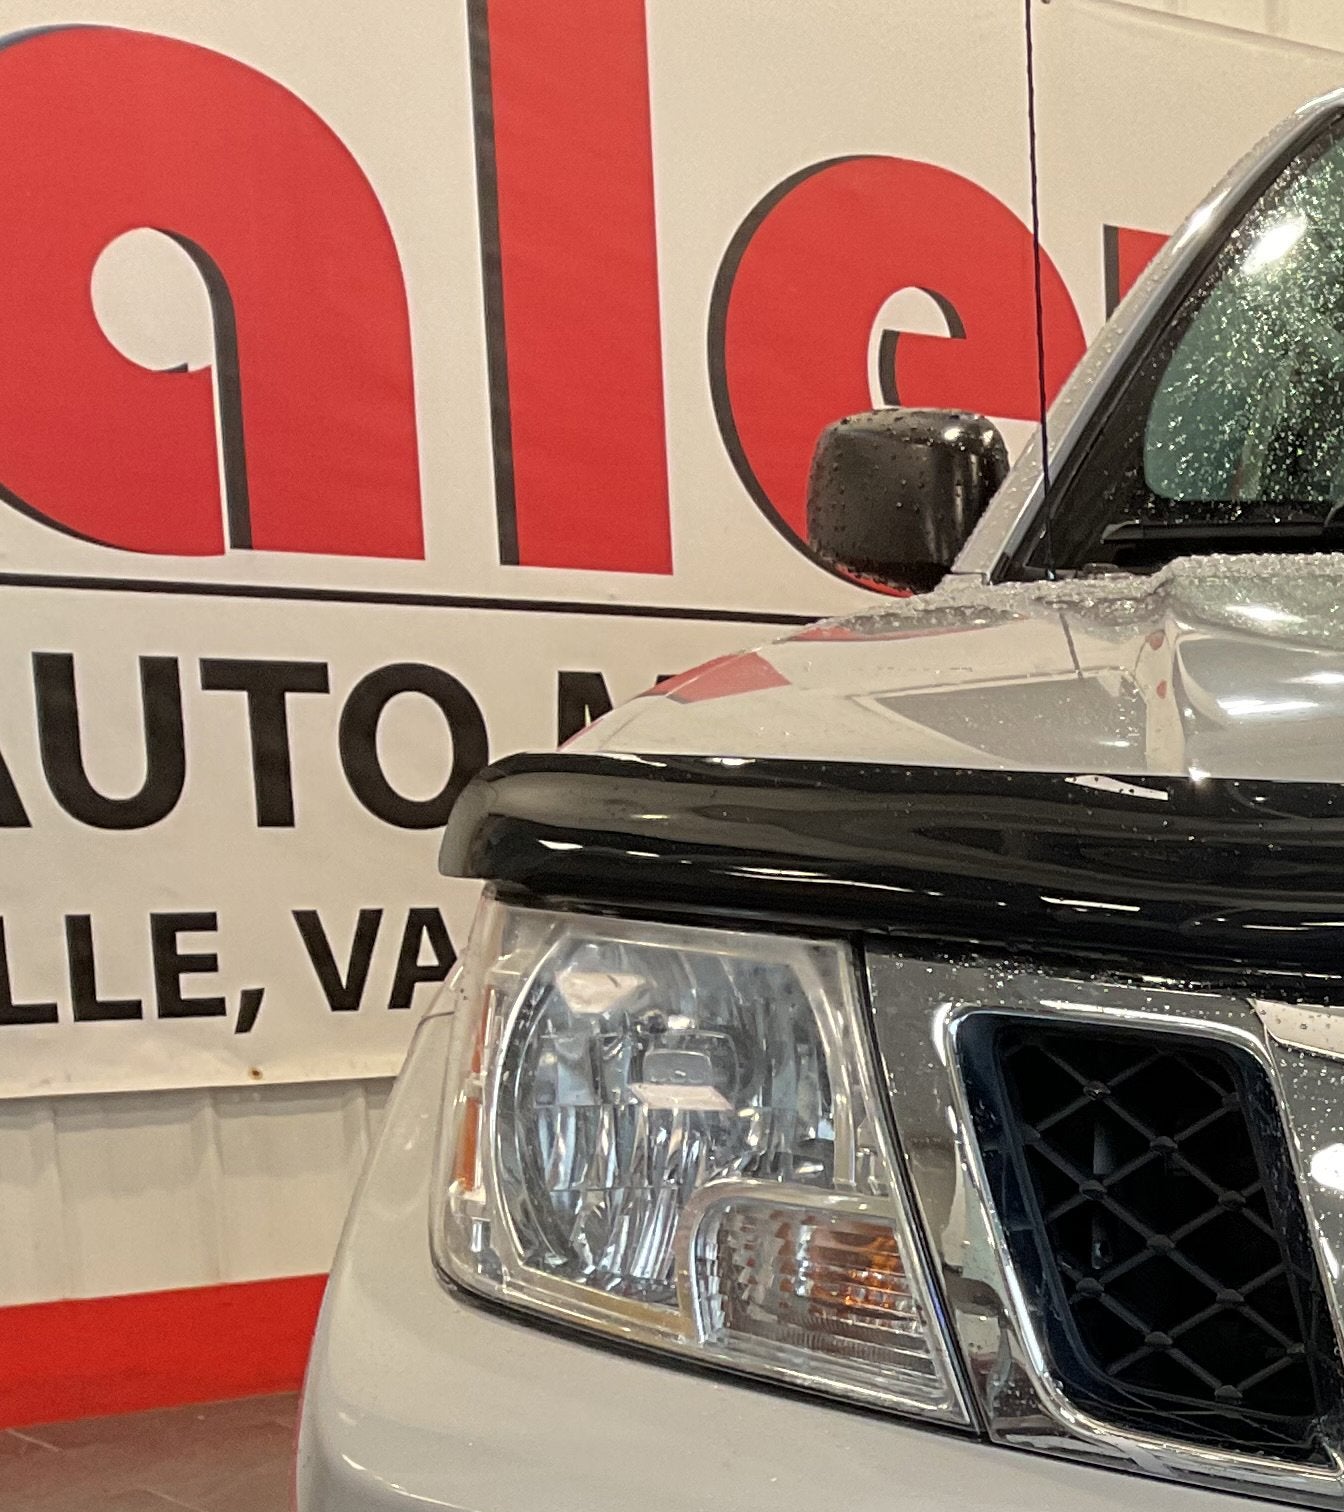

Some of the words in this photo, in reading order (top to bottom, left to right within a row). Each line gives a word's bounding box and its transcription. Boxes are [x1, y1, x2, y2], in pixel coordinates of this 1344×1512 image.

[0, 0, 1172, 597] ale
[0, 652, 489, 830] UTO
[292, 908, 457, 1011] VA
